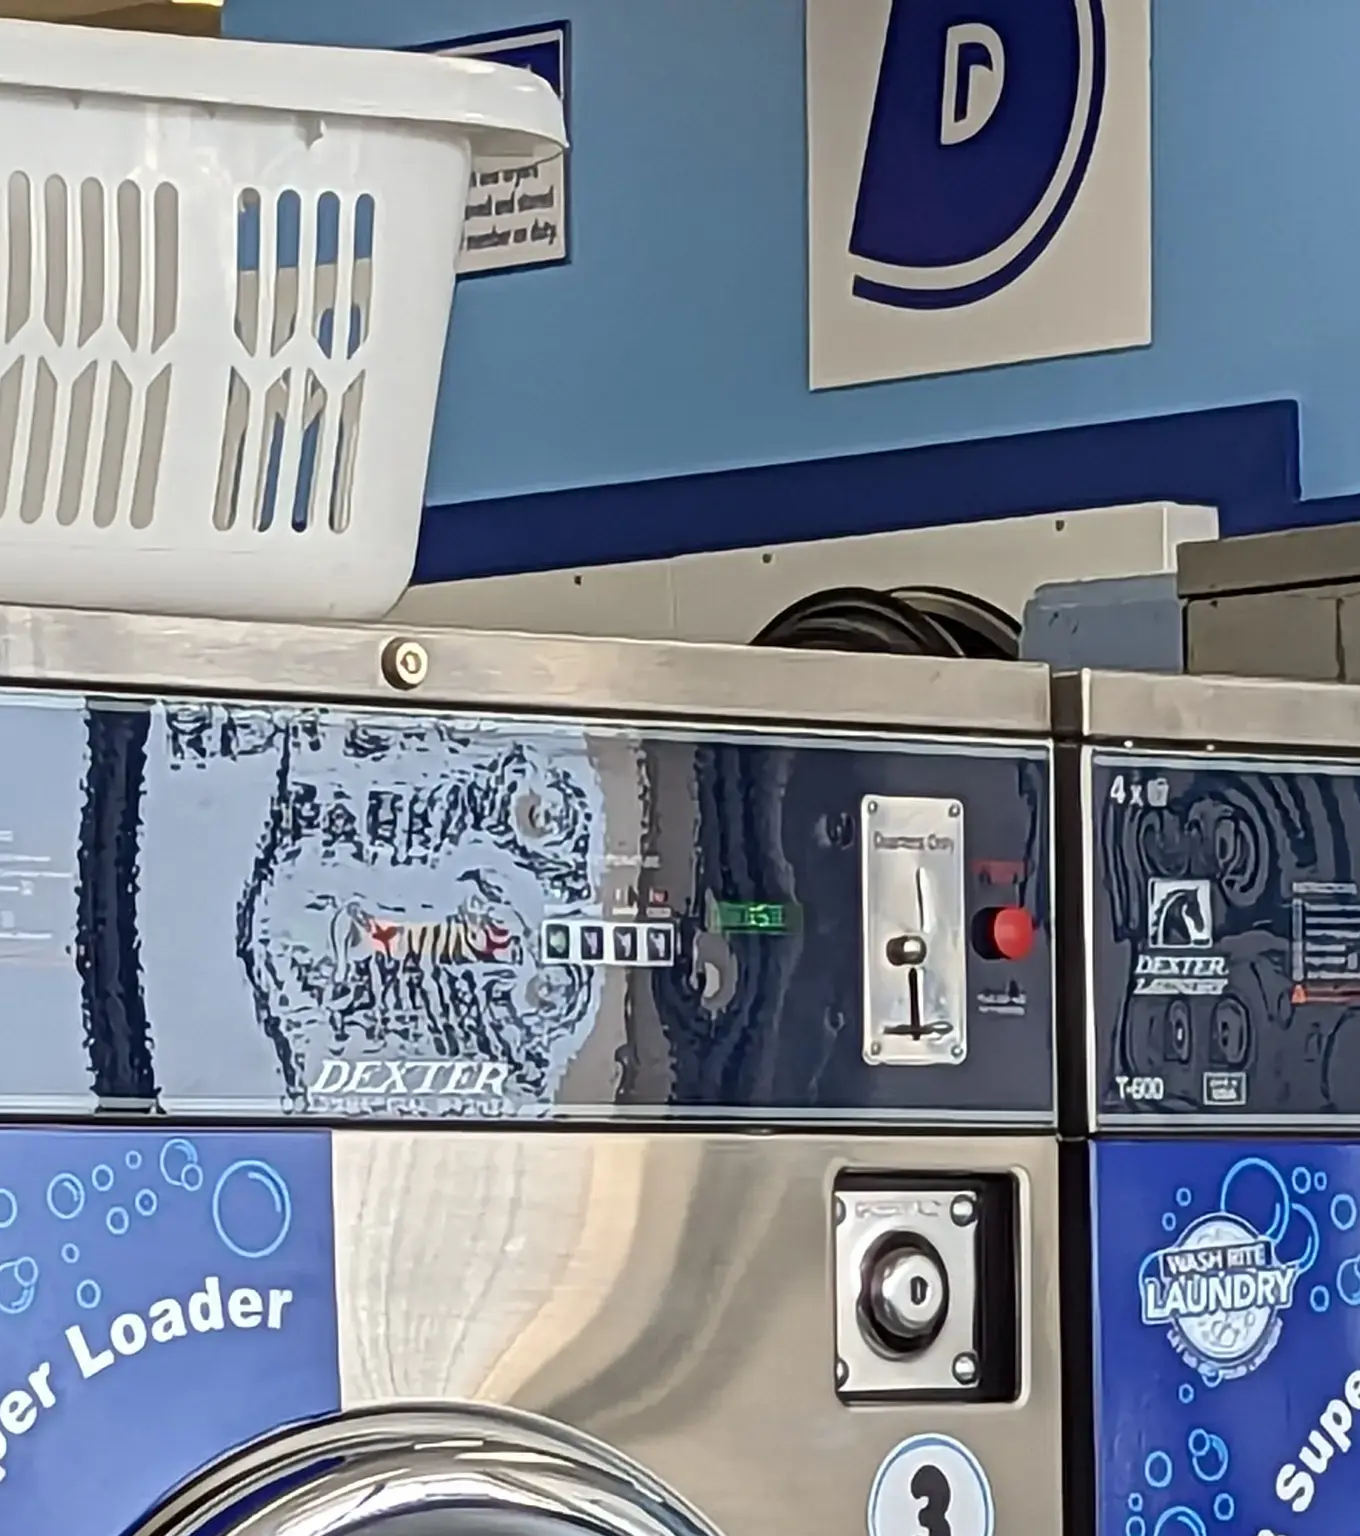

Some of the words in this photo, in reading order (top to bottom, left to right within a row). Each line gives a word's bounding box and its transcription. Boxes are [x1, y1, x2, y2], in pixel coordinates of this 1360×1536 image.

[1110, 775, 1126, 804] 4
[1130, 785, 1144, 806] x
[1134, 954, 1227, 976] DEXTER
[308, 1060, 510, 1096] DEXTER
[1146, 1267, 1295, 1320] LAUNDRY
[65, 1276, 294, 1381] Loader
